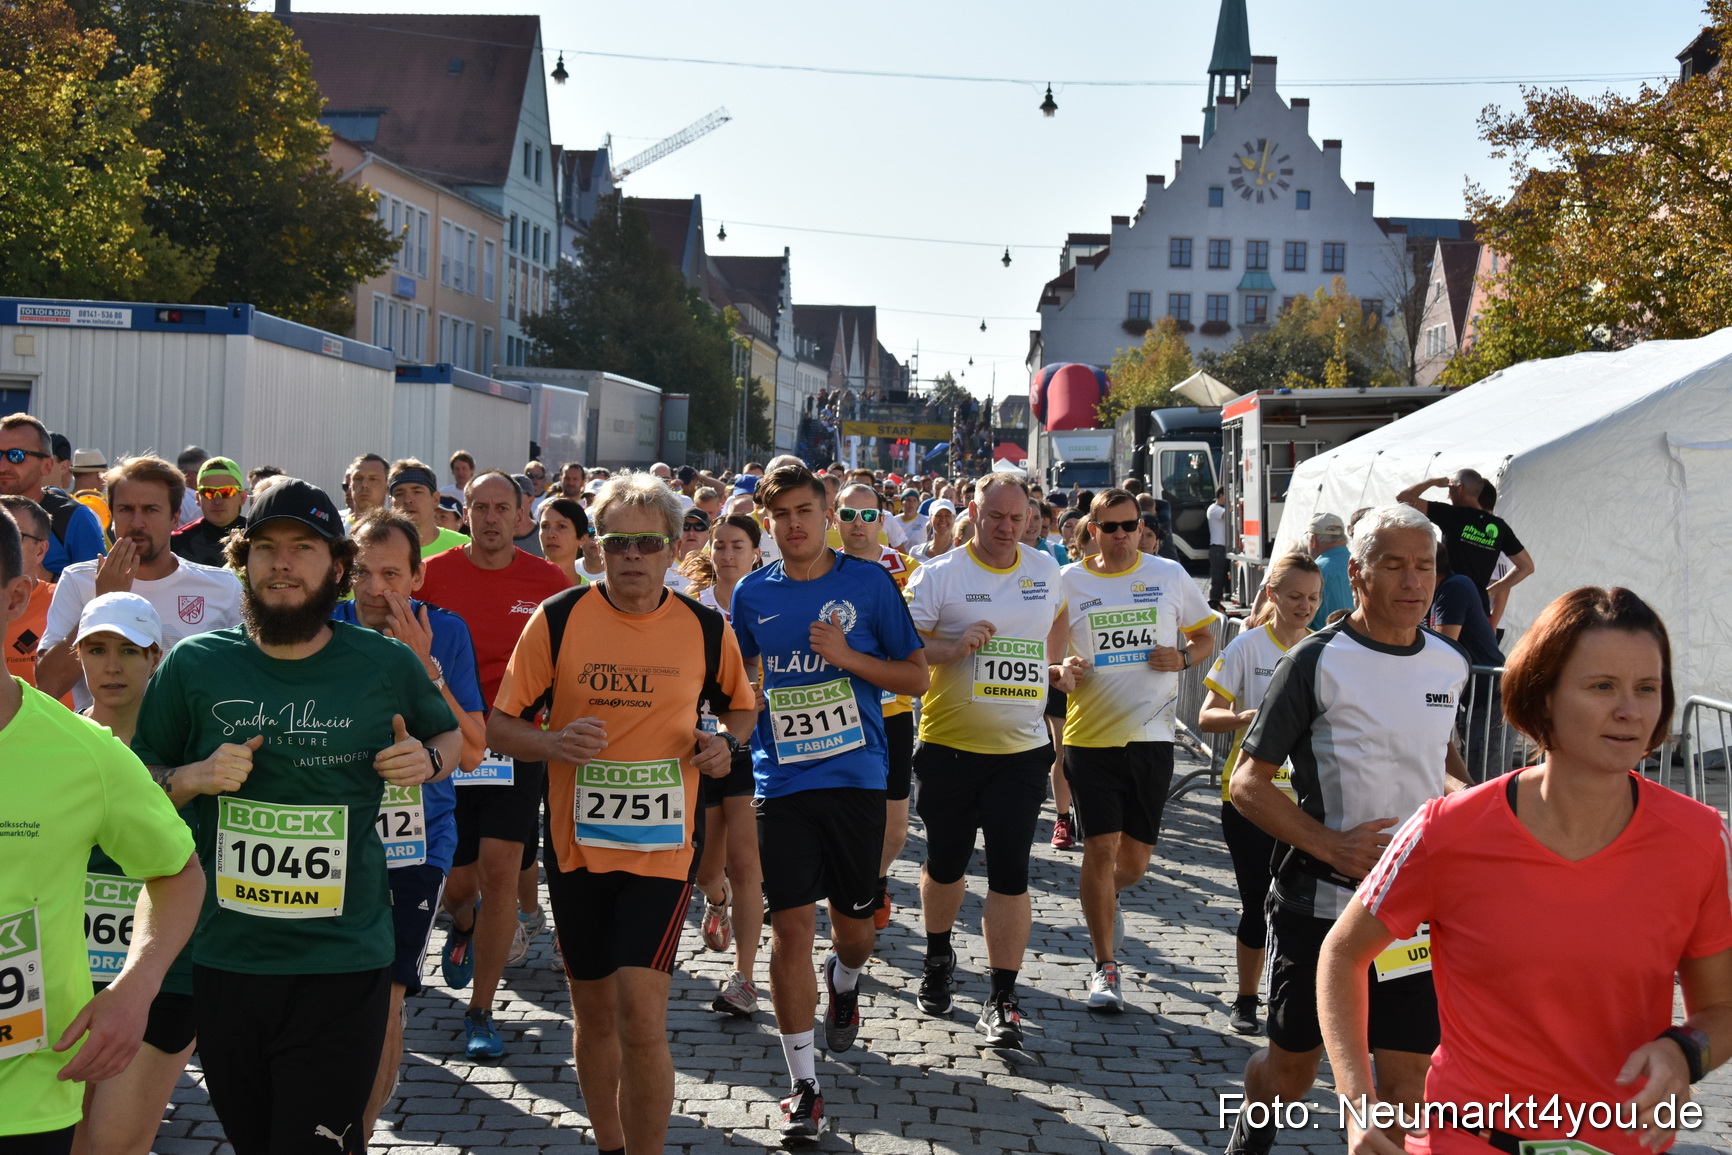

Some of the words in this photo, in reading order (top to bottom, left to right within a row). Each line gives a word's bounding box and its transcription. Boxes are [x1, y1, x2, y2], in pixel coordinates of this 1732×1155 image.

[54, 309, 70, 317] DIXI
[878, 426, 916, 436] START
[1021, 579, 1033, 588] 20
[1132, 584, 1145, 592] 20
[1092, 609, 1154, 628] BOCK
[1098, 628, 1152, 650] 2644
[982, 640, 1040, 657] BOCK
[1108, 652, 1146, 663] DIETER
[984, 660, 1039, 682] 1095
[590, 673, 654, 693] OEXL
[984, 686, 1038, 697] GERHARD
[589, 698, 611, 706] CIBA
[621, 700, 652, 708] VISION
[776, 682, 847, 708] BOCK
[1426, 693, 1449, 703] swn
[212, 699, 279, 736] Sandra
[780, 706, 847, 737] 2311
[246, 736, 328, 747] FISEURE
[796, 735, 844, 753] FABIAN
[293, 751, 369, 768] LAUTERHOFEN
[584, 763, 675, 786] BOCK
[587, 792, 669, 820] 2751
[227, 802, 336, 836] BOCK
[231, 840, 330, 880] 1046
[235, 884, 319, 905] BASTIAN
[28, 963, 35, 973] S
